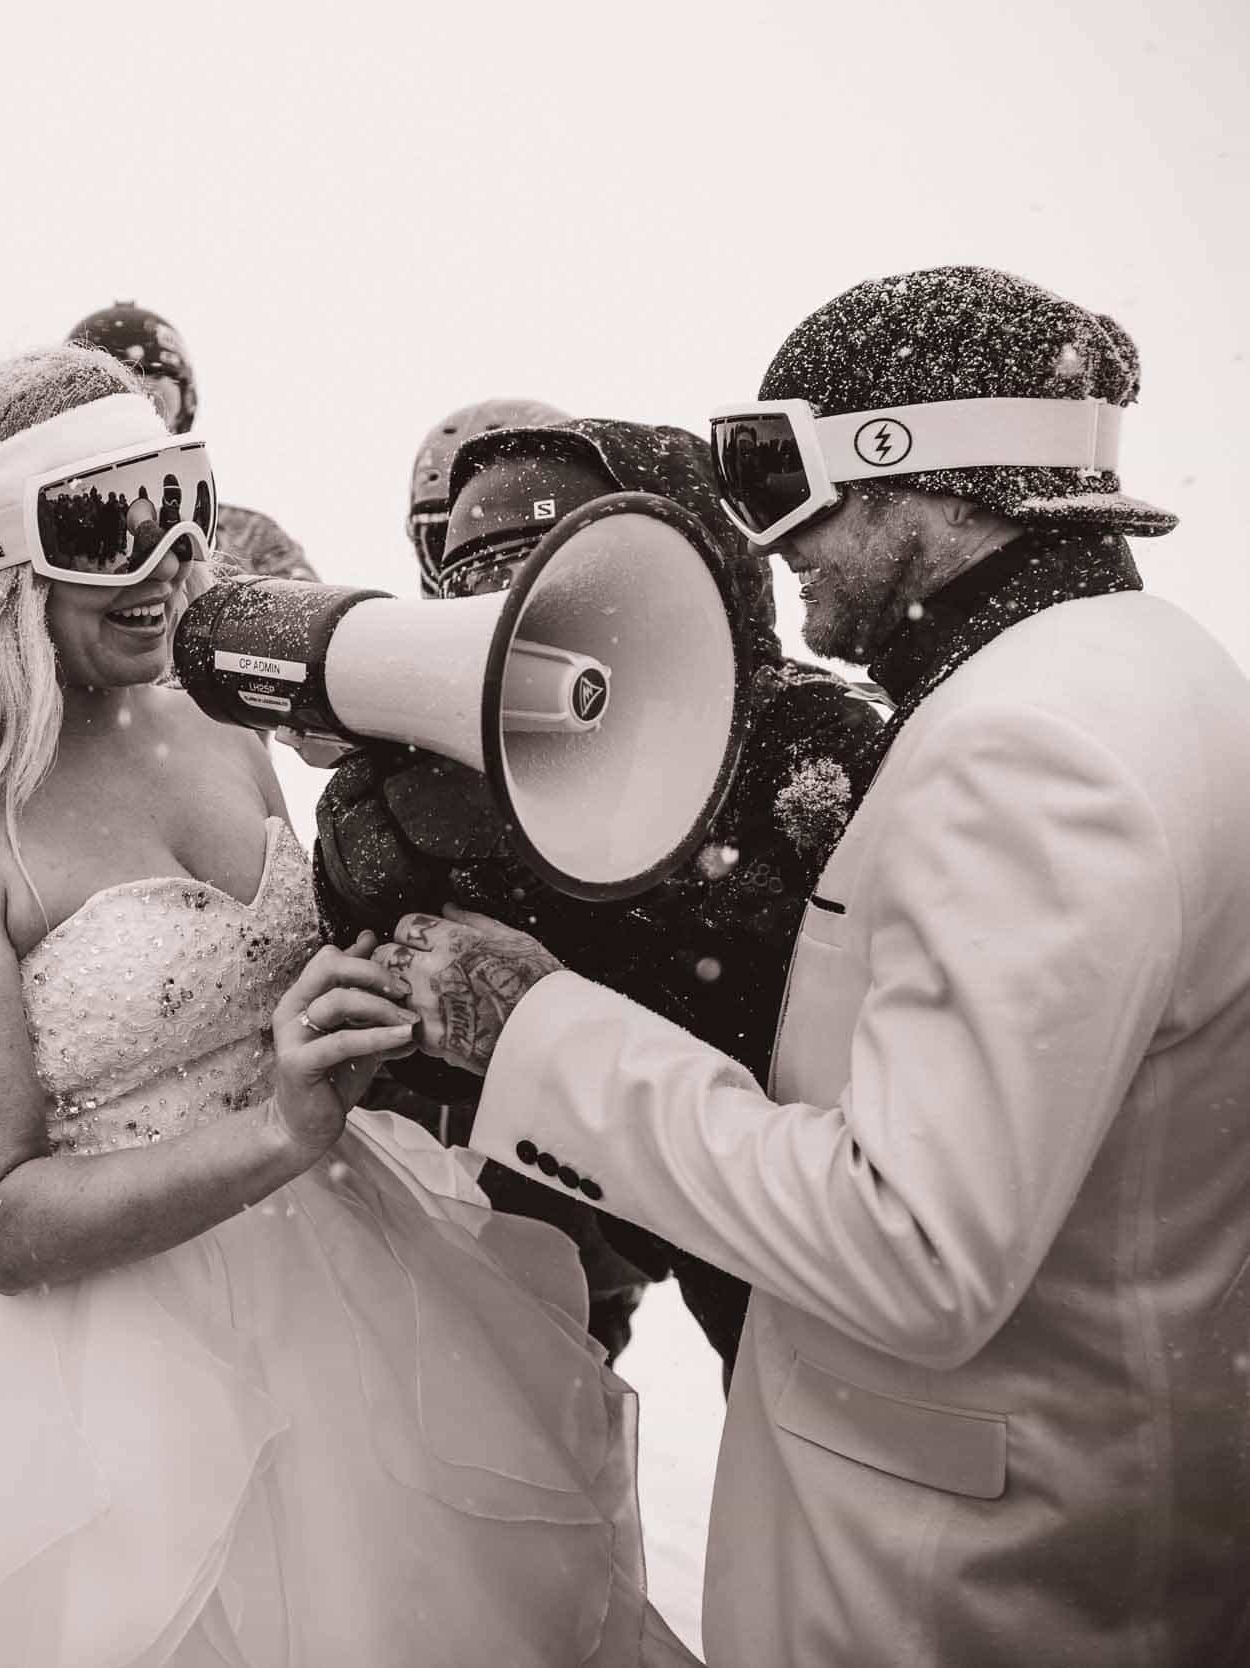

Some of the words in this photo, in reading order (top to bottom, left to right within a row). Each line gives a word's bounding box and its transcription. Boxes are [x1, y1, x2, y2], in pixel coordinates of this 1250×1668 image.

[536, 502, 552, 517] S
[239, 657, 251, 670] CP
[253, 660, 280, 674] ADMIN
